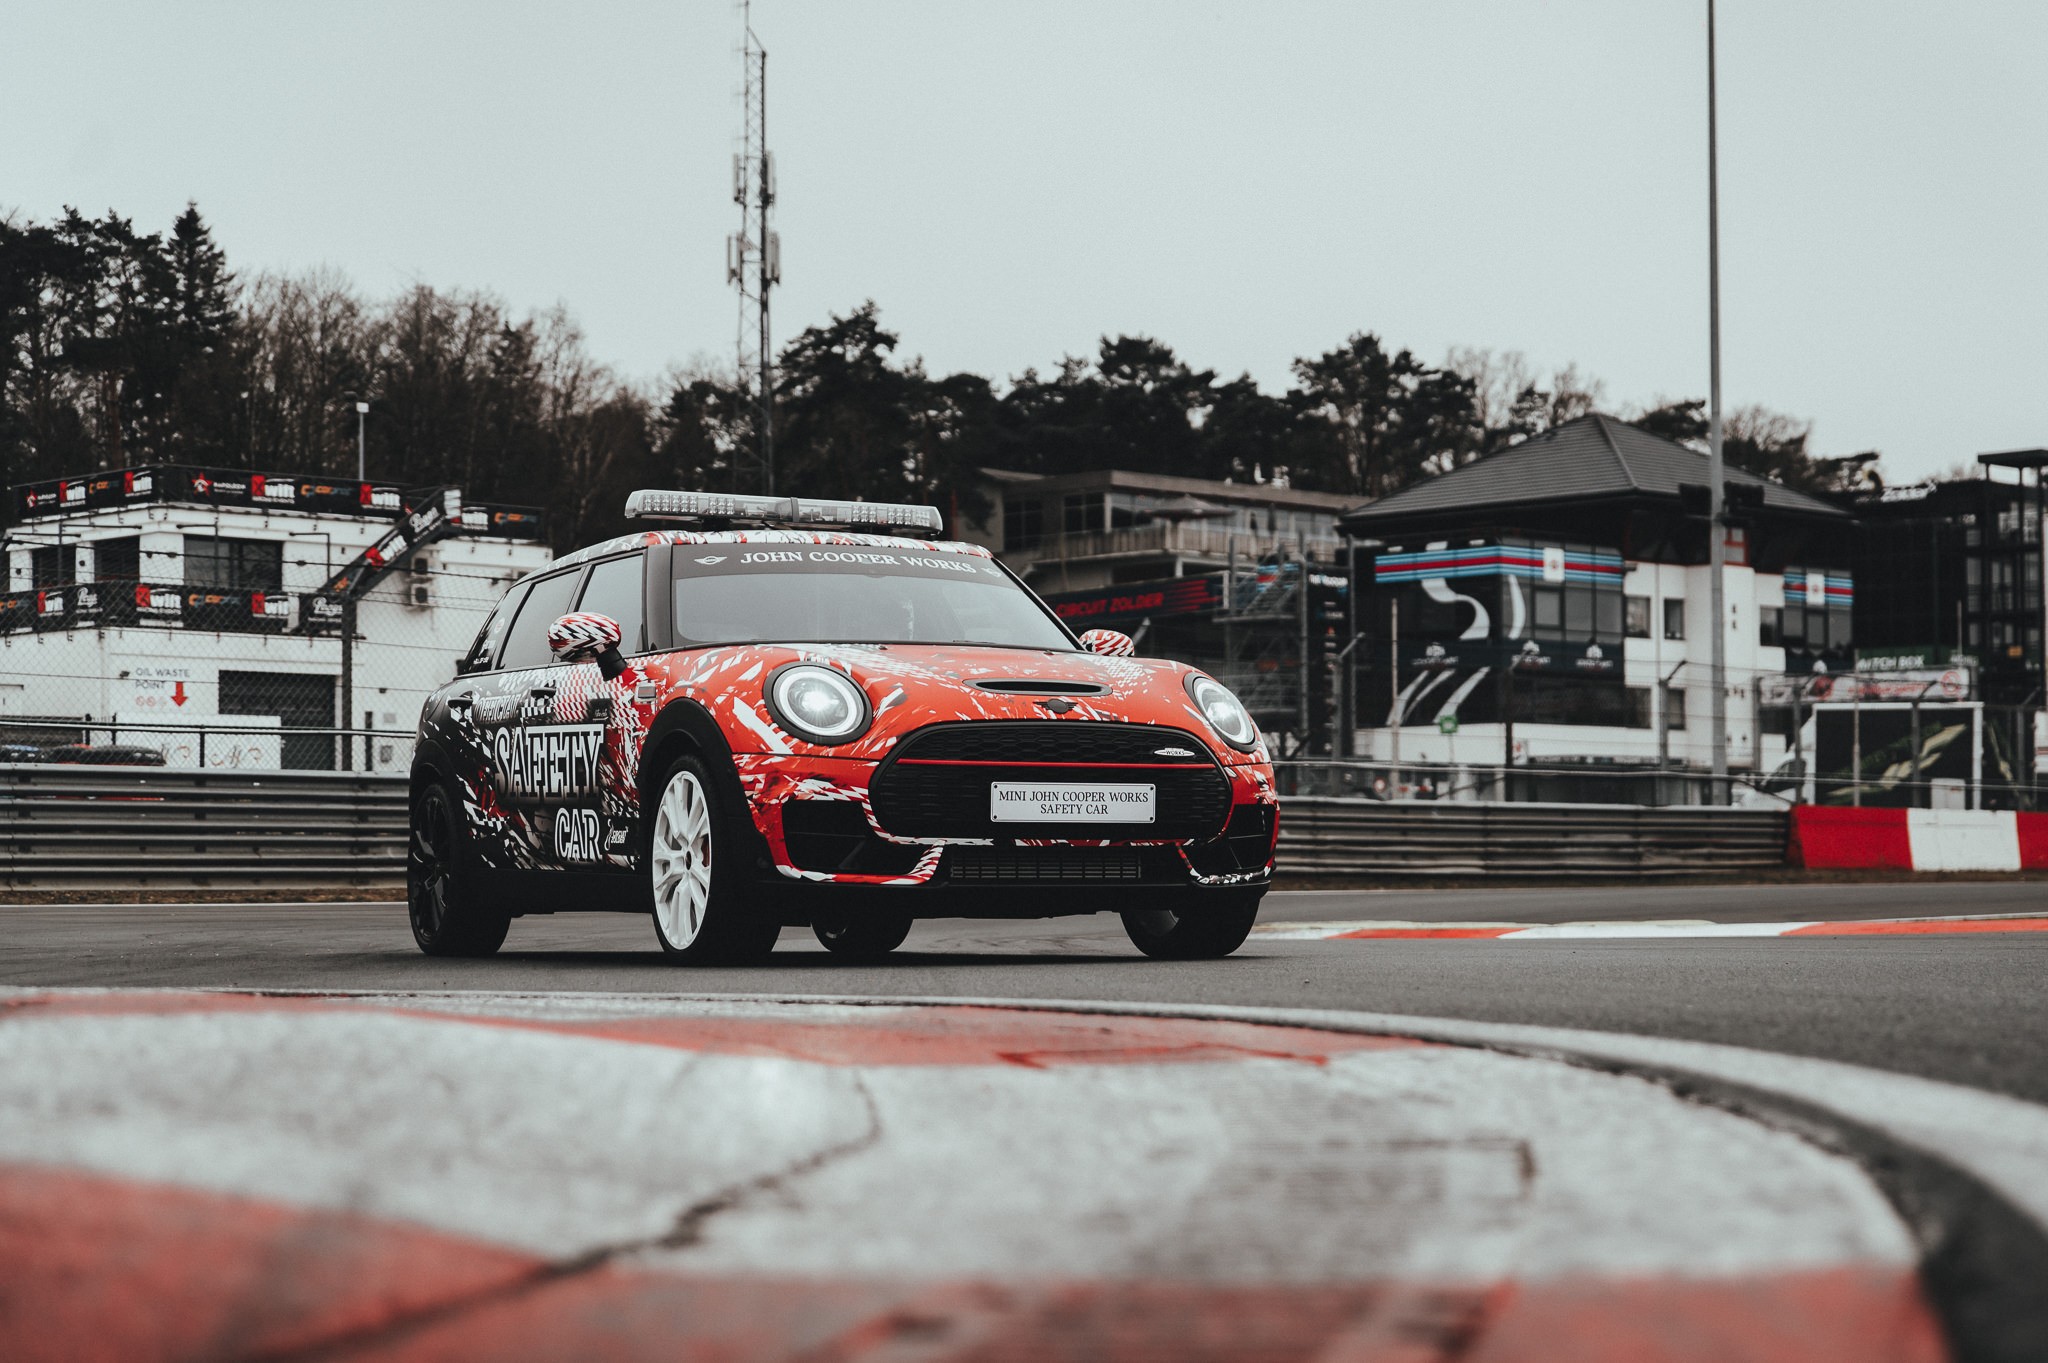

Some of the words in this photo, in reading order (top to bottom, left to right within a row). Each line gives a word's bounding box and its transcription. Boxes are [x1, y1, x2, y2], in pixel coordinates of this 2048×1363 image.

[740, 552, 803, 565] JOHN
[808, 551, 900, 566] COOPER
[900, 556, 977, 574] WORKS
[1056, 600, 1107, 618] CIRCUIT
[1109, 593, 1164, 614] ZOLDER
[135, 667, 152, 677] OIL
[156, 668, 190, 678] WASTE
[135, 680, 166, 689] POINT
[494, 724, 604, 799] SAFETY
[999, 790, 1026, 801] MINI
[1030, 791, 1059, 802] JOHN
[1062, 791, 1105, 802] COOPER
[1109, 792, 1149, 803] WORKS
[1040, 803, 1082, 814] SAFETY
[1086, 804, 1108, 814] CAR
[554, 807, 602, 862] CAR
